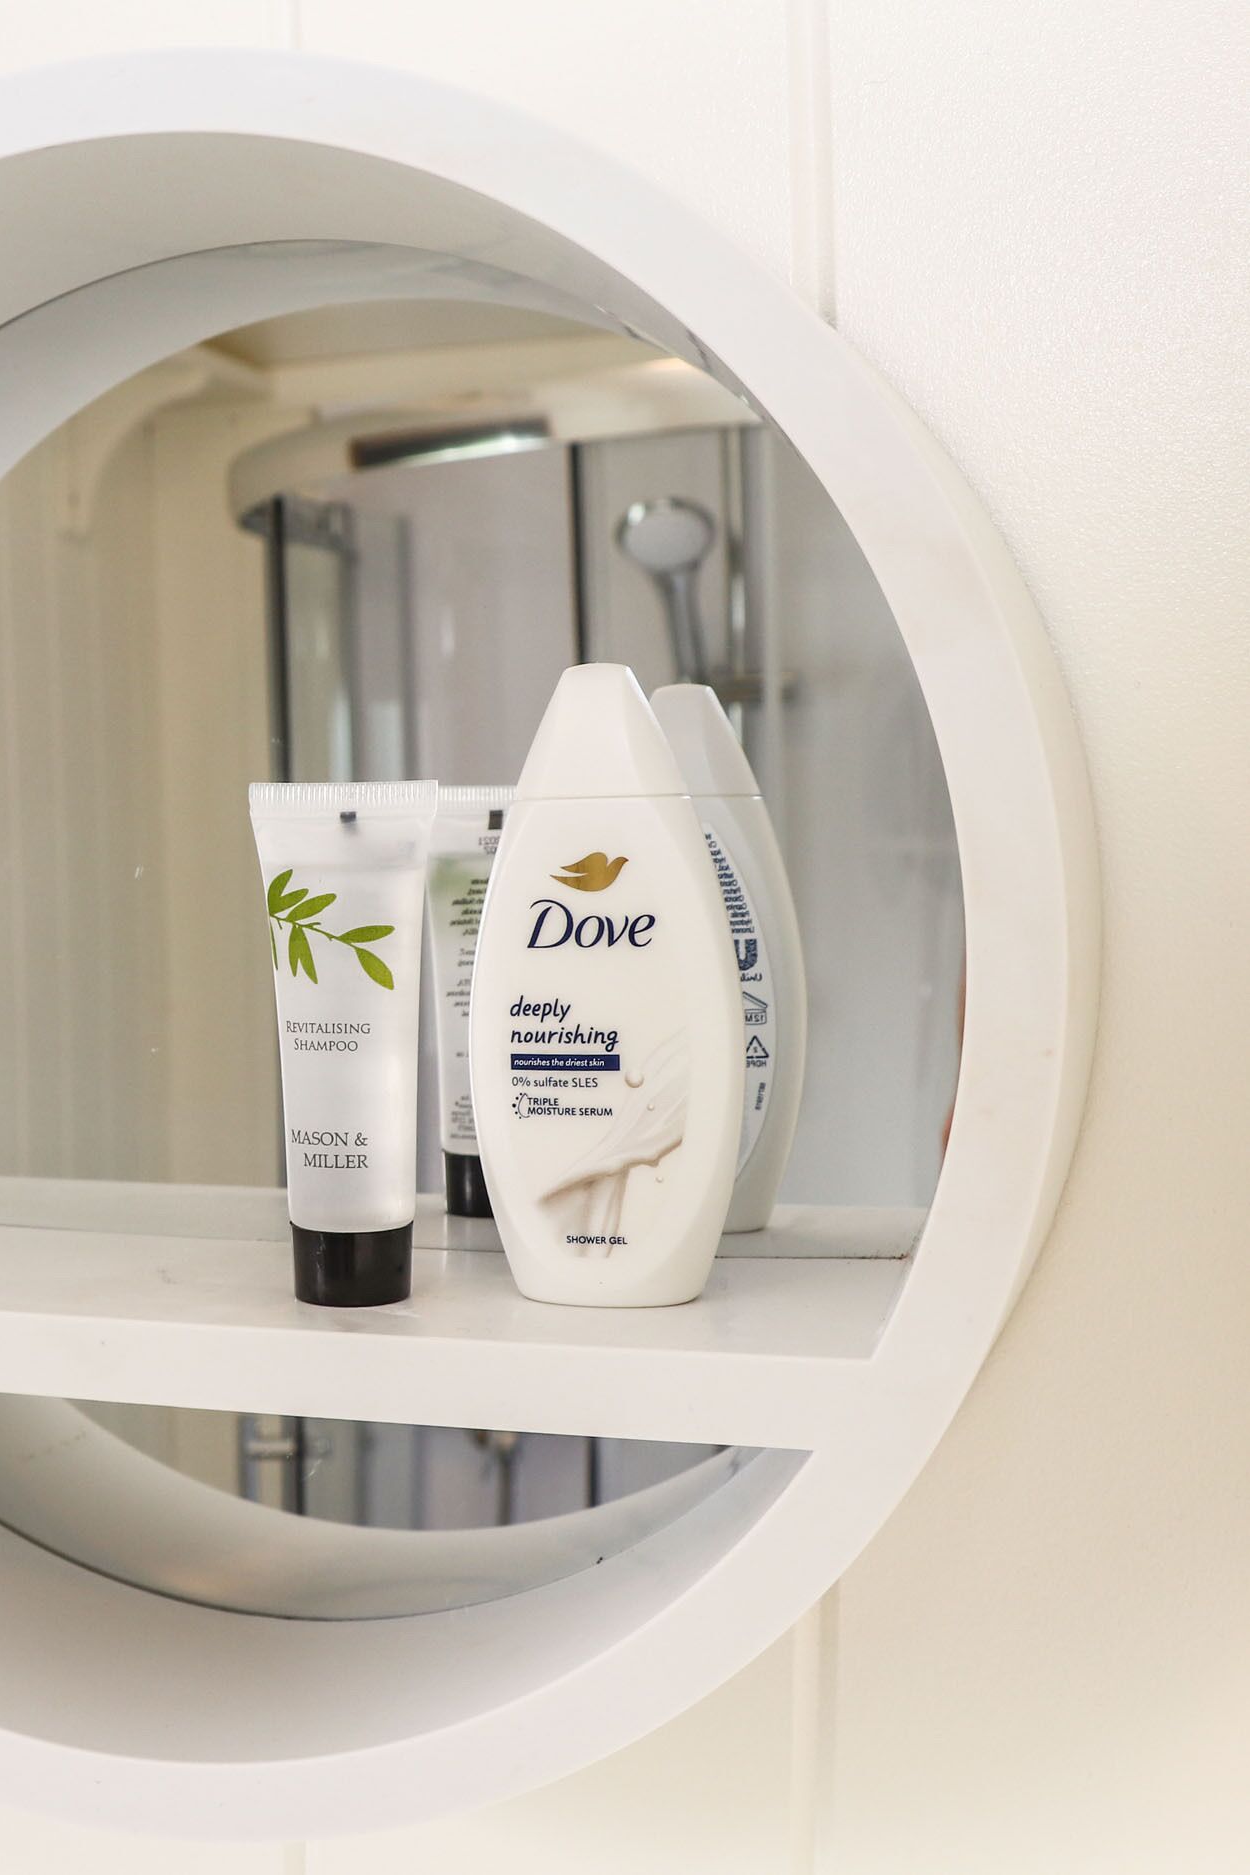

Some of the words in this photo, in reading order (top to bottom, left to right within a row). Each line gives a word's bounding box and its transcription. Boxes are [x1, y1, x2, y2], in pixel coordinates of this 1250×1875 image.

[526, 898, 656, 949] Dove
[510, 995, 571, 1023] deeply
[286, 1020, 371, 1034] REVITALISING
[294, 1038, 358, 1051] SHAMPOO
[510, 1024, 619, 1052] nourishing
[513, 1058, 550, 1066] nourishes
[551, 1058, 564, 1067] the
[565, 1059, 588, 1067] driest
[589, 1058, 605, 1067] skin
[512, 1076, 531, 1087] 0%
[533, 1077, 569, 1087] sulfate
[571, 1077, 598, 1088] SLES
[527, 1097, 559, 1106] TRIPLE
[527, 1107, 576, 1116] MOISTURE
[578, 1107, 613, 1116] SERUM
[291, 1129, 349, 1147] MASON
[354, 1132, 368, 1147] &
[303, 1152, 368, 1169] MILLER
[566, 1235, 607, 1245] SHOWER
[608, 1236, 628, 1245] GEL
